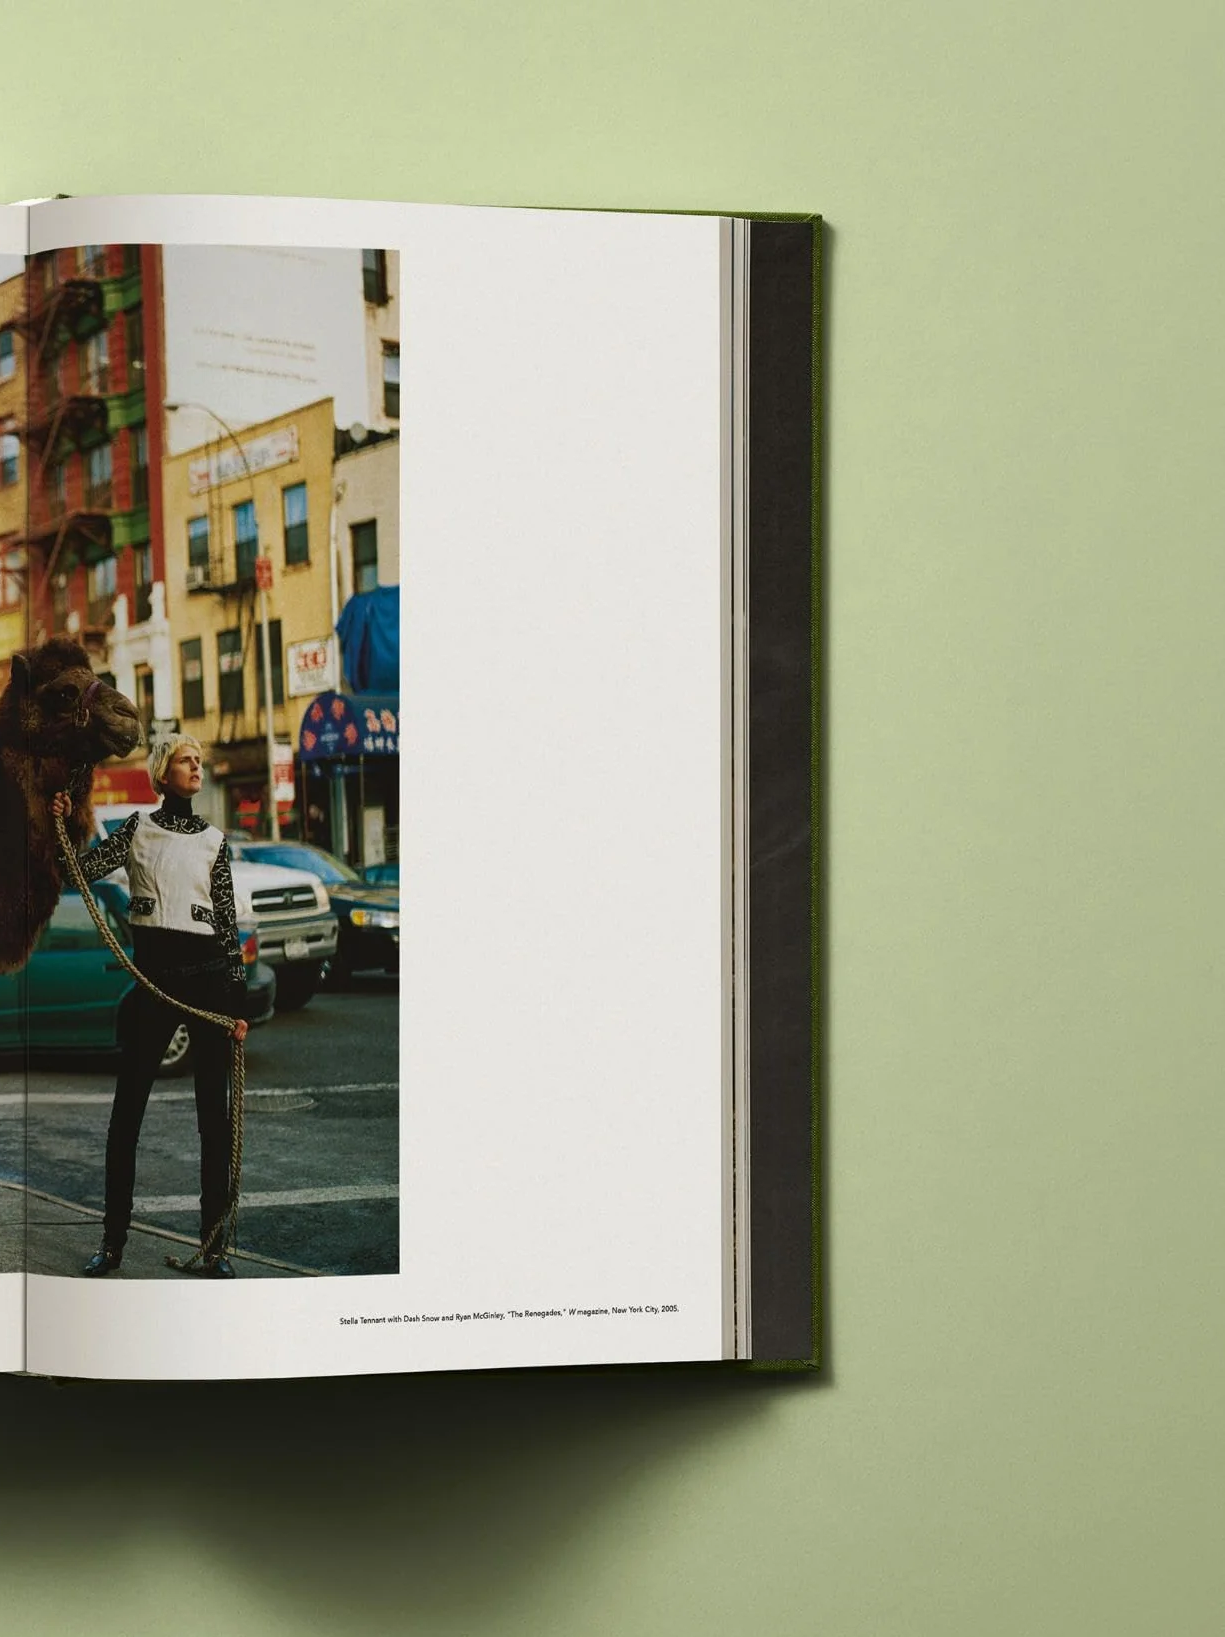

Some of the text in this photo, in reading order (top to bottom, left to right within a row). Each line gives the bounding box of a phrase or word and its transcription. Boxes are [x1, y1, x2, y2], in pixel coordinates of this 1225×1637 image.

[339, 1317, 358, 1325] Stella
[360, 1316, 386, 1325] Tennant
[387, 1315, 403, 1323] with
[403, 1314, 421, 1323] Dash
[421, 1314, 440, 1322] Snow
[441, 1313, 454, 1321] and
[455, 1313, 472, 1322] Ryan
[473, 1311, 506, 1320] McGinley,
[568, 1308, 577, 1316] W
[576, 1308, 610, 1317] magazine,
[611, 1306, 627, 1314] New
[628, 1305, 644, 1313] York
[644, 1305, 660, 1314] City,
[661, 1304, 680, 1313] 2005.
